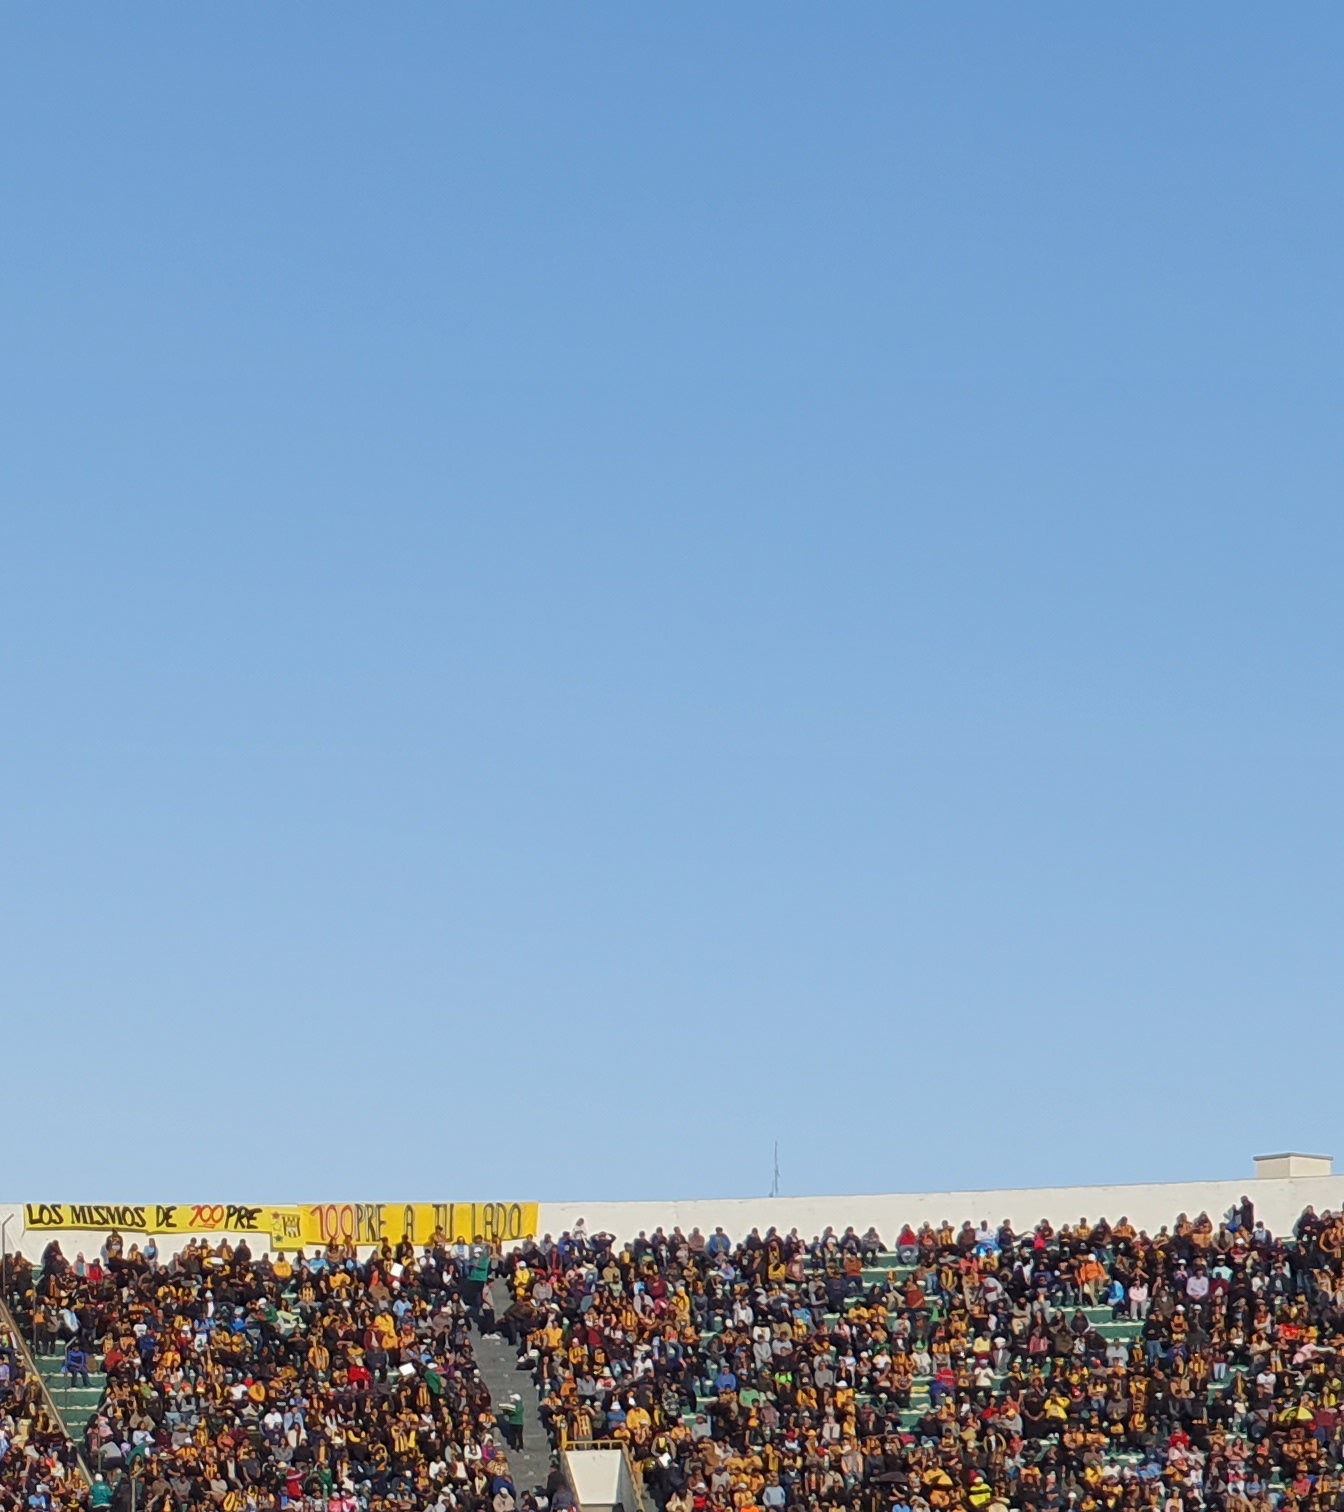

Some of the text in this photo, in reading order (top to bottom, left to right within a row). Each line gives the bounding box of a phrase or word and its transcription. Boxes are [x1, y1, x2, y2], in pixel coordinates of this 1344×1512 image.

[26, 1203, 63, 1225] LOS
[70, 1205, 146, 1227] MISMOS
[156, 1205, 177, 1228] DE
